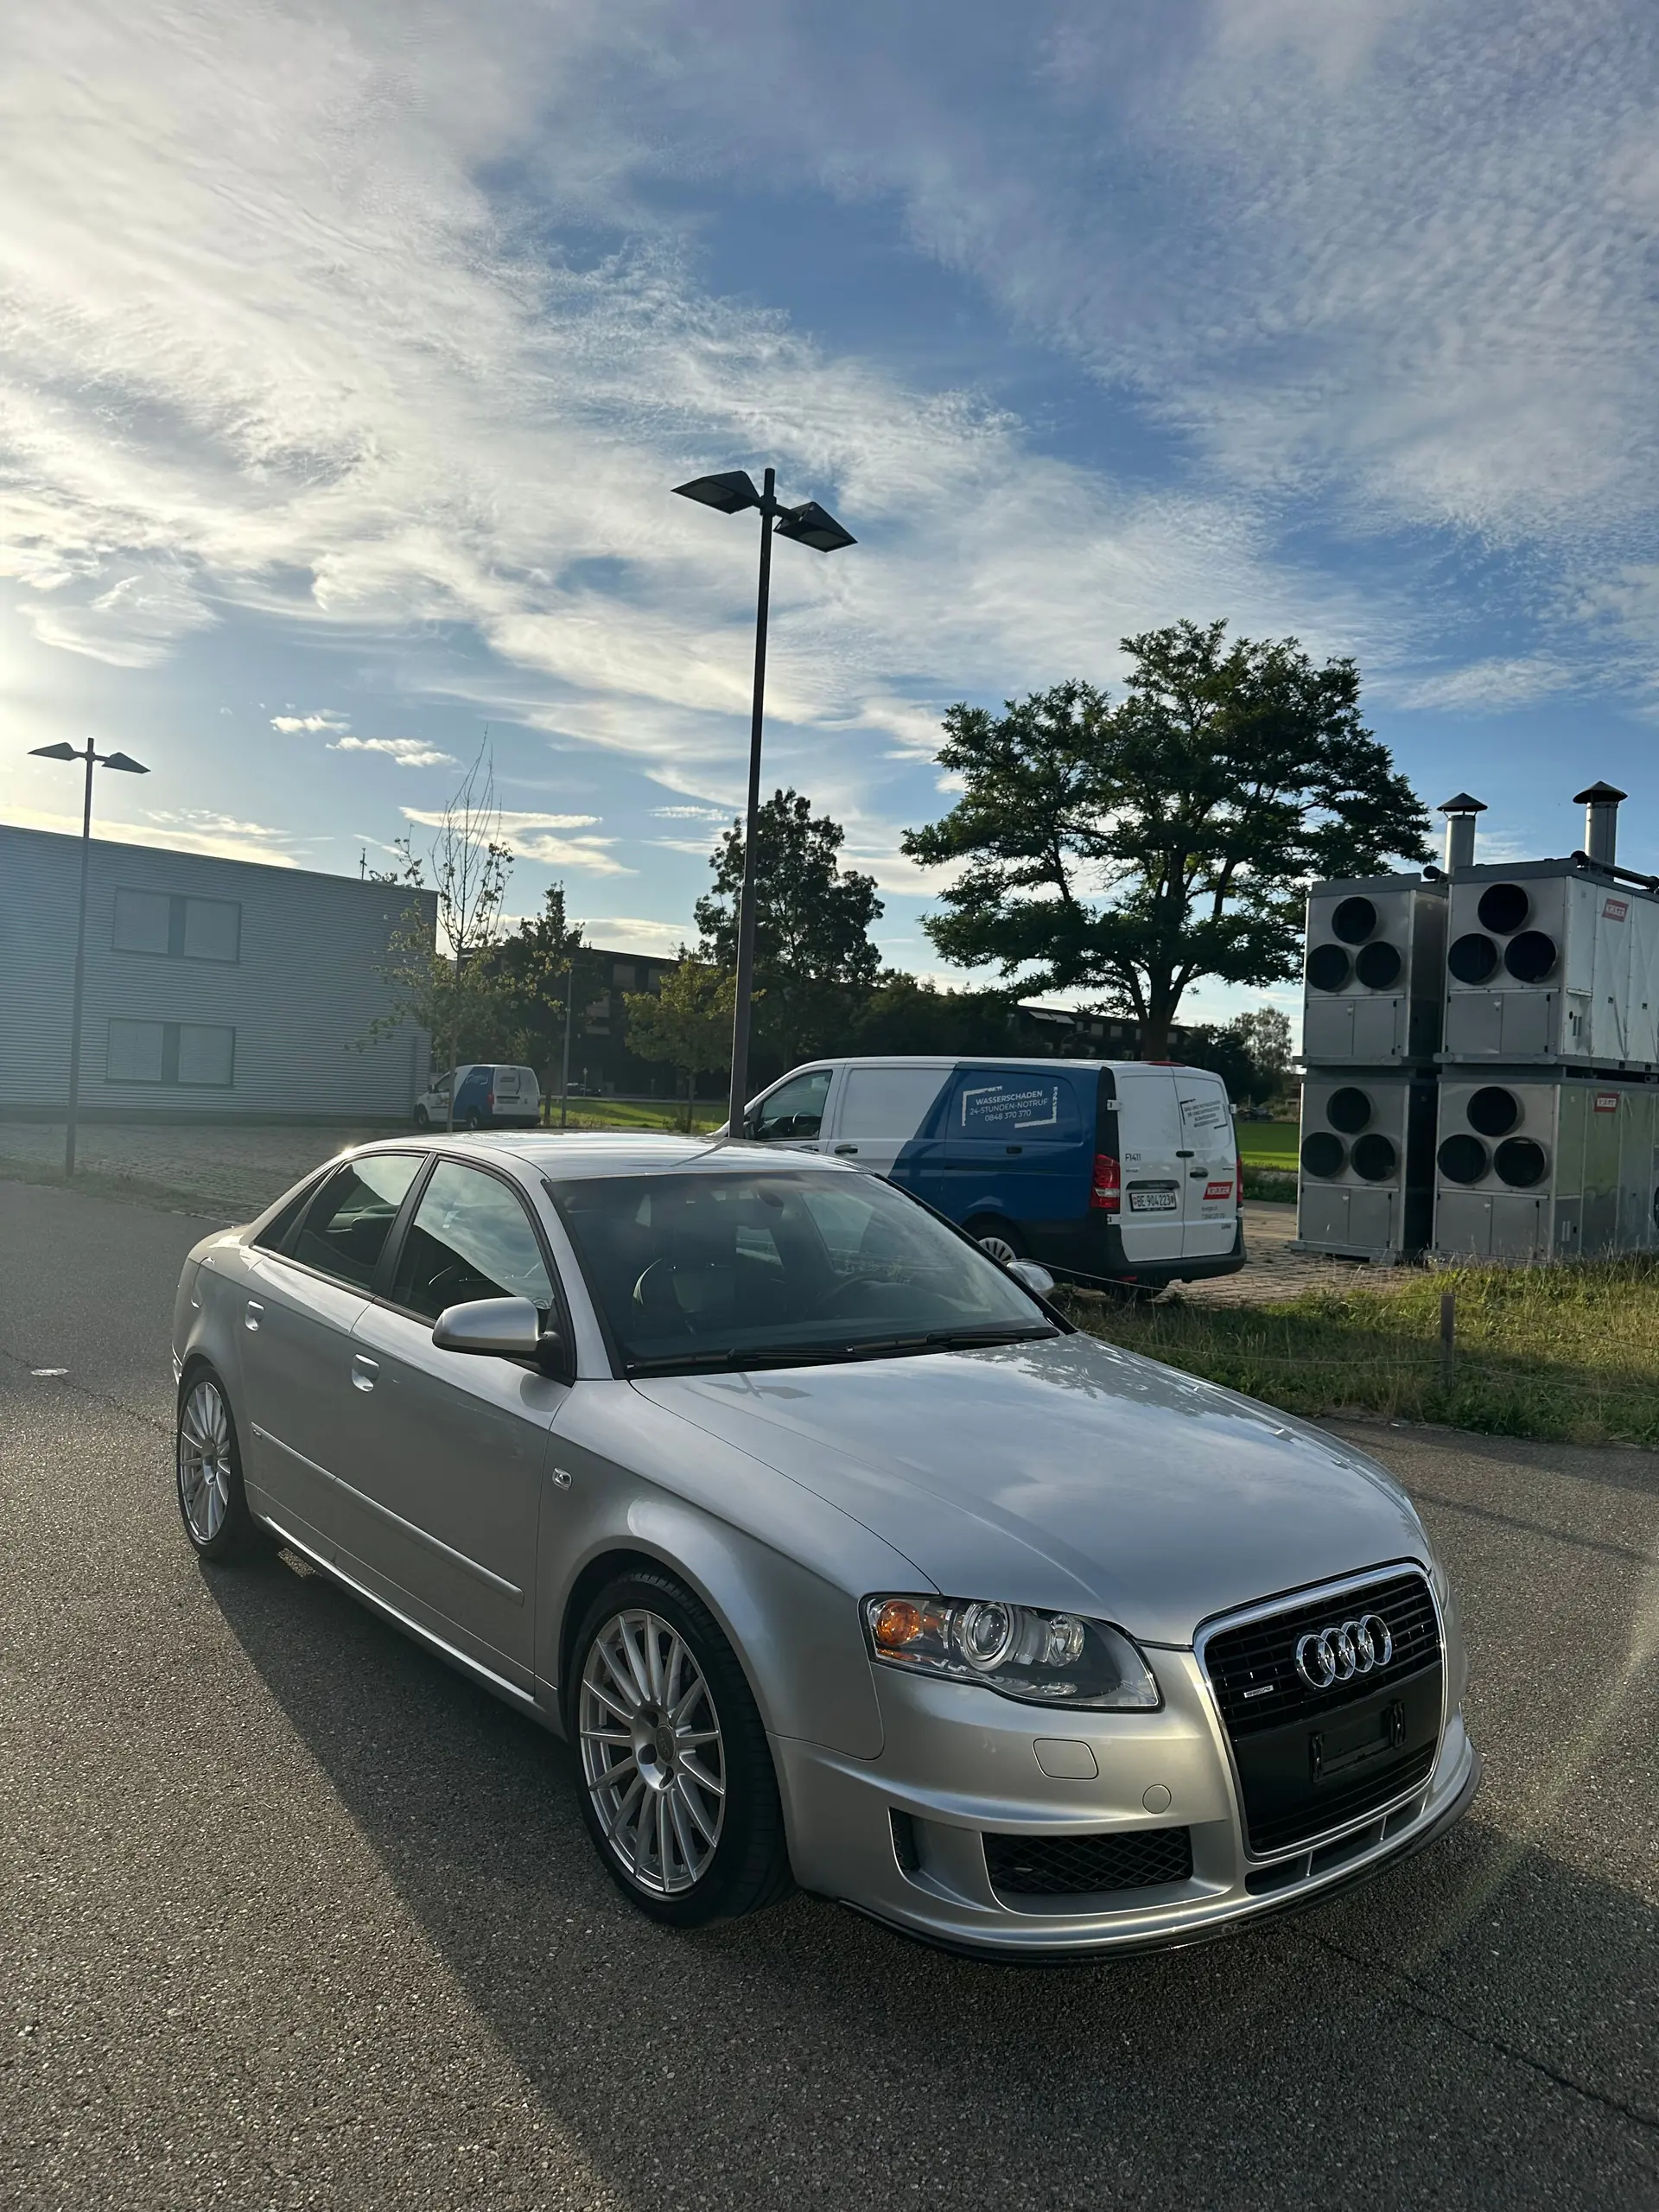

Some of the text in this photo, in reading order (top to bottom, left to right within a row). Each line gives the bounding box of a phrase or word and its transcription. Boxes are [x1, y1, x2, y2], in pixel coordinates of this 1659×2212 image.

[976, 1090, 1043, 1105] WASSERSCHADEN
[969, 1098, 1049, 1116] 24-STUNDEN-NOTRUF
[1004, 1111, 1017, 1120] 370
[1125, 1153, 1141, 1161] F1411
